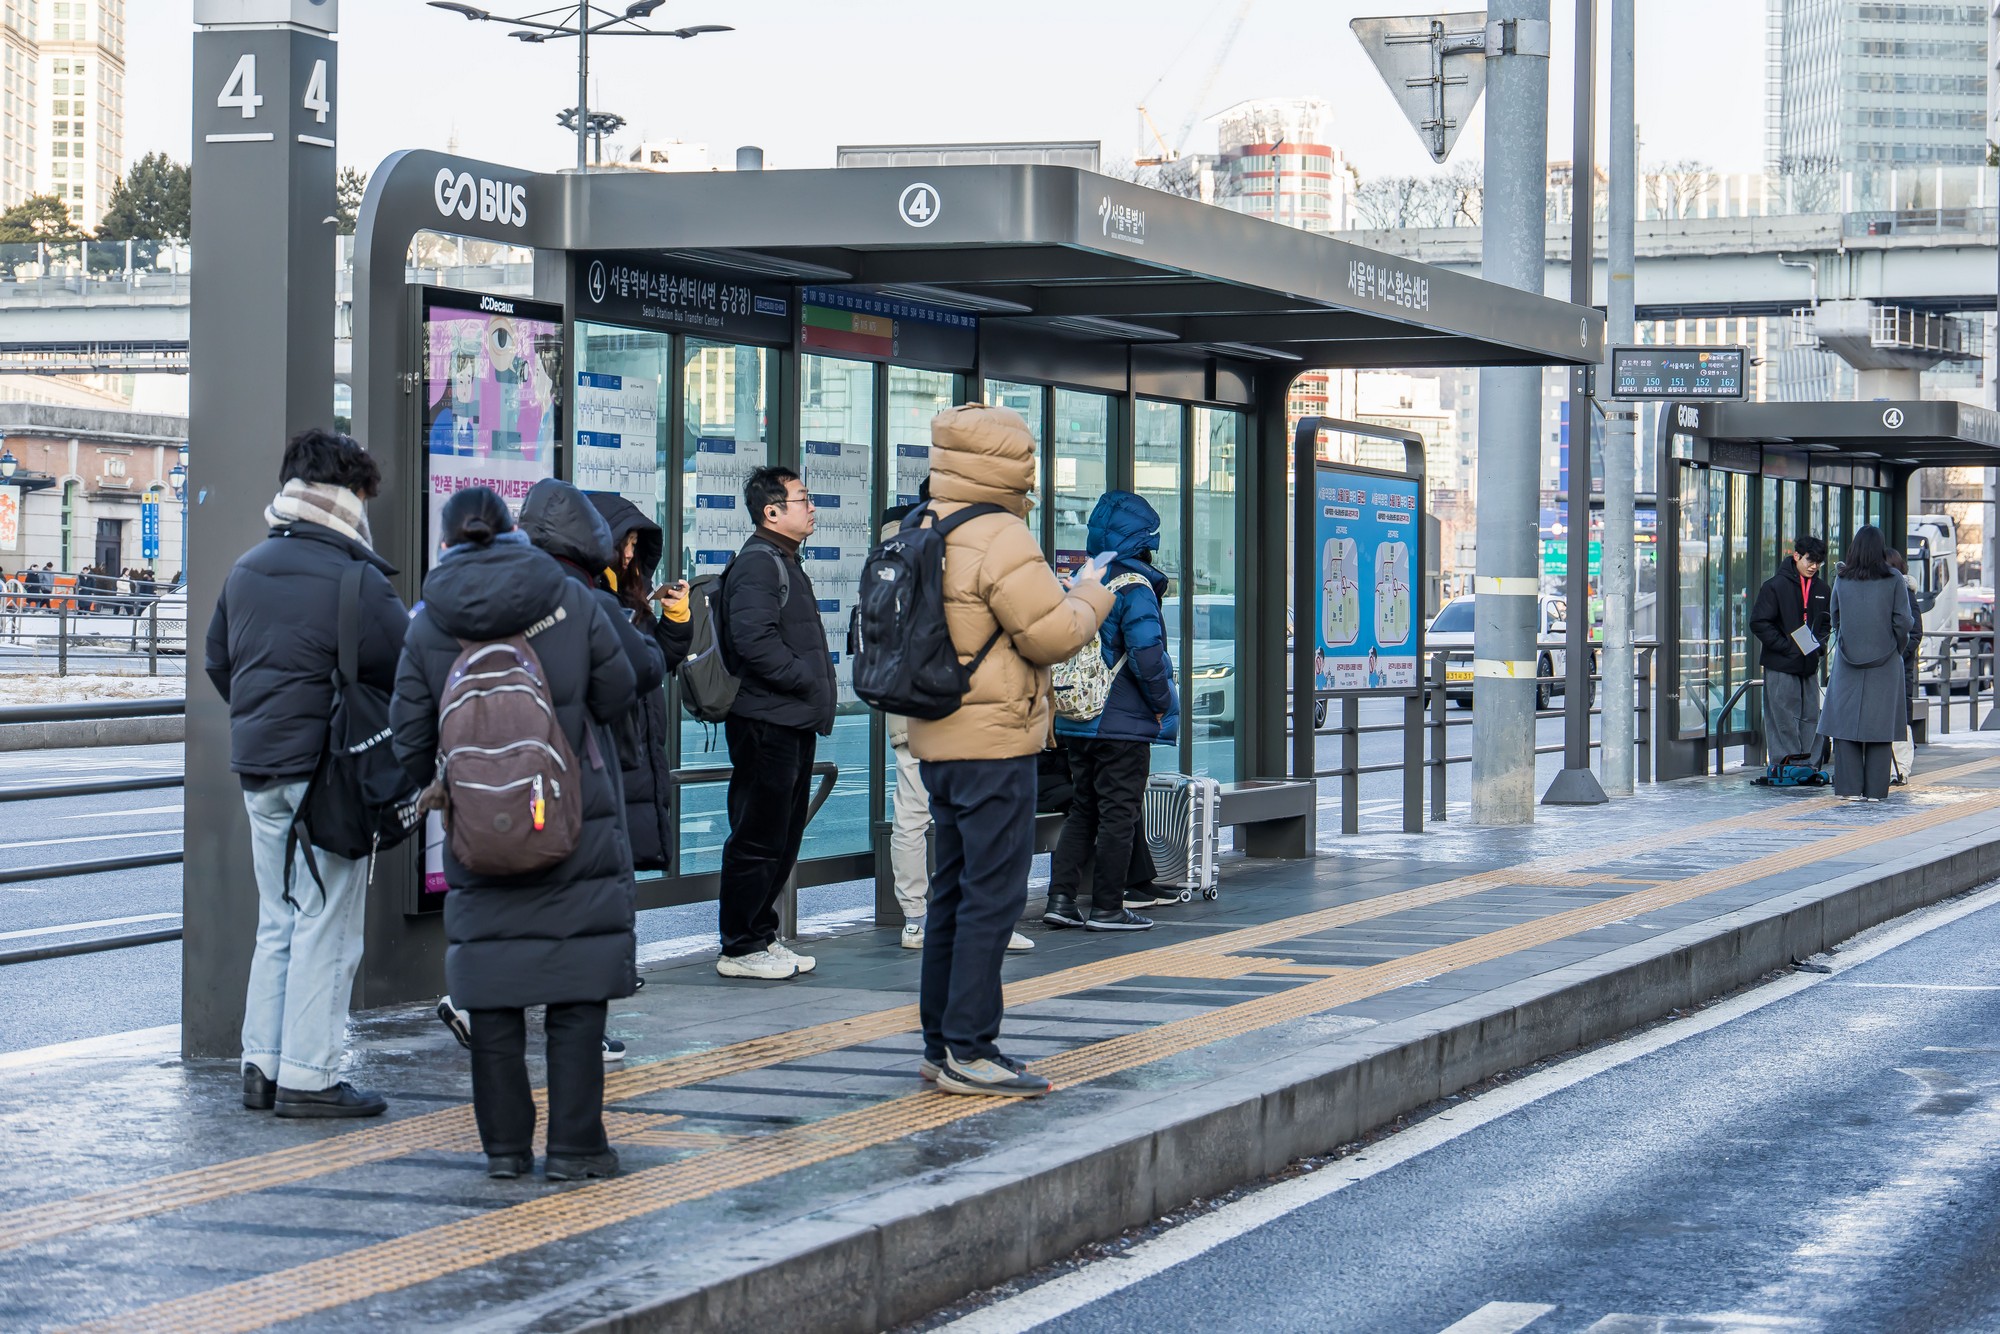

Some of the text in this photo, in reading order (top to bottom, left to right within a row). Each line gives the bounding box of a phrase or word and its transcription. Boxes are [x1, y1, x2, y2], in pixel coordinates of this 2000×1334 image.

[217, 54, 263, 118] 4
[304, 59, 330, 123] 4
[434, 167, 527, 227] GO BUS
[1111, 204, 1145, 235] 서울특별시
[609, 265, 717, 311] 서울역버스환승센터(4번
[720, 284, 751, 316] 승강장)
[809, 291, 817, 301] 100
[1348, 260, 1429, 311] 서울역 버스환승센터
[480, 295, 514, 314] JCDecaux
[642, 304, 656, 318] Seoul
[656, 306, 674, 320] Station
[674, 309, 684, 322] Bus
[684, 310, 704, 325] Transfer
[704, 313, 720, 326] Center
[1668, 362, 1695, 370] 서울특별시
[581, 375, 591, 388] 100
[1621, 377, 1735, 387] 100 150 151 152 162
[581, 434, 591, 446] 150
